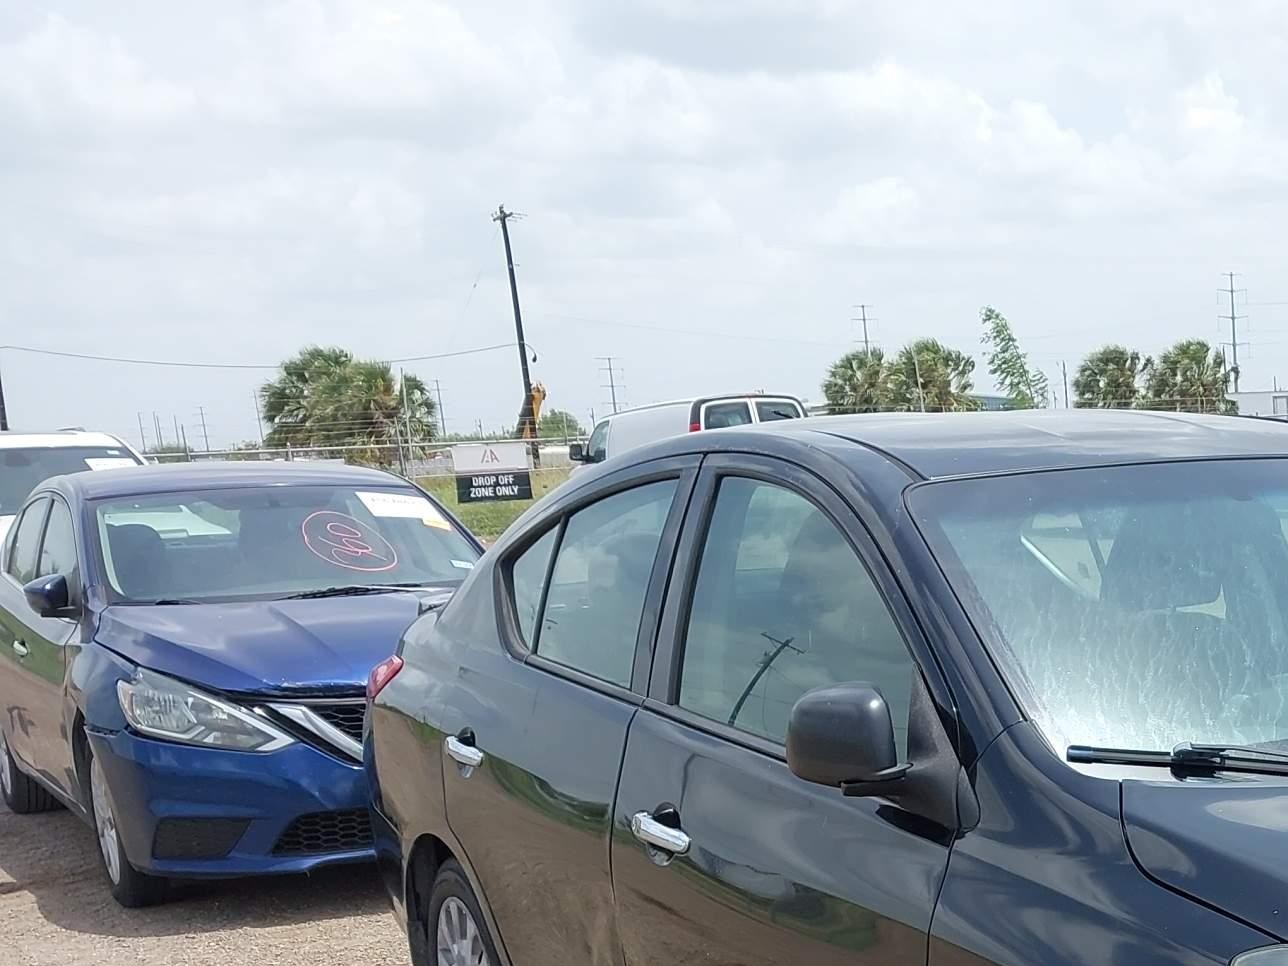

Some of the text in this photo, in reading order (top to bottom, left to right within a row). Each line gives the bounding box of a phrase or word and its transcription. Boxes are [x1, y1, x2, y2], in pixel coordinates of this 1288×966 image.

[472, 474, 514, 486] DROP OFF
[470, 485, 519, 498] ZONE ONLY
